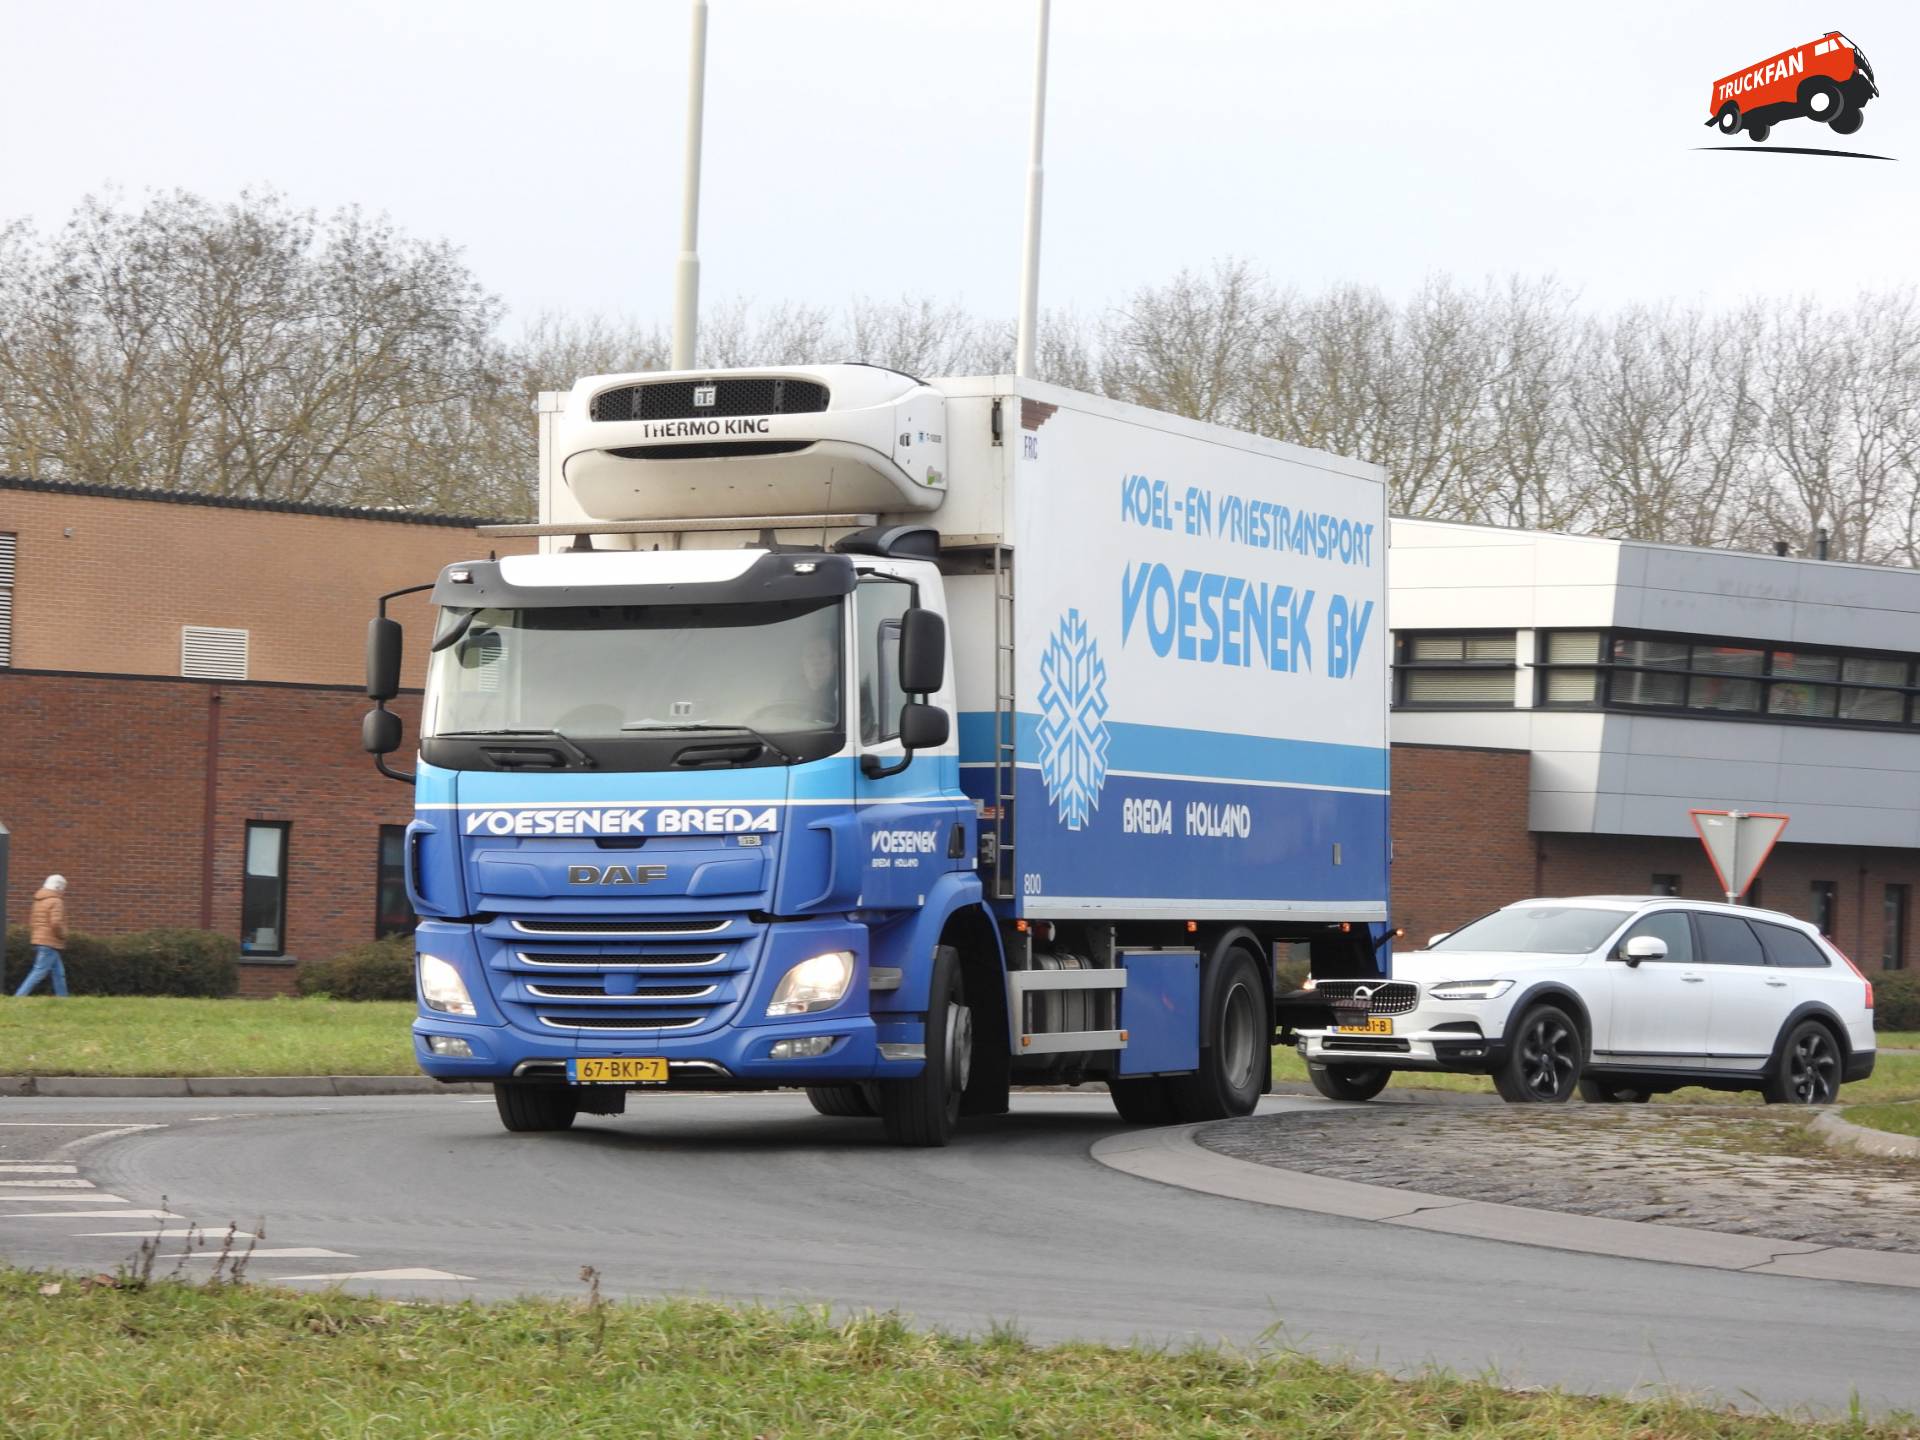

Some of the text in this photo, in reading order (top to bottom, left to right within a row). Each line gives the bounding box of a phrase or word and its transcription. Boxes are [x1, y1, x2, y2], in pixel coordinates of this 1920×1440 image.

[643, 419, 769, 438] THERMO KING
[1024, 435, 1038, 460] FRC
[1218, 495, 1374, 567] VRIESTRANSPORT
[1122, 560, 1374, 680] VOESENEK BV
[466, 807, 778, 835] VOESENEK BREDA
[1122, 798, 1251, 839] BREDA HOLLAND
[872, 830, 937, 853] VOESENEK
[567, 864, 668, 886] DAF
[1024, 873, 1041, 894] 800
[583, 1061, 660, 1078] 67-BKP-7
